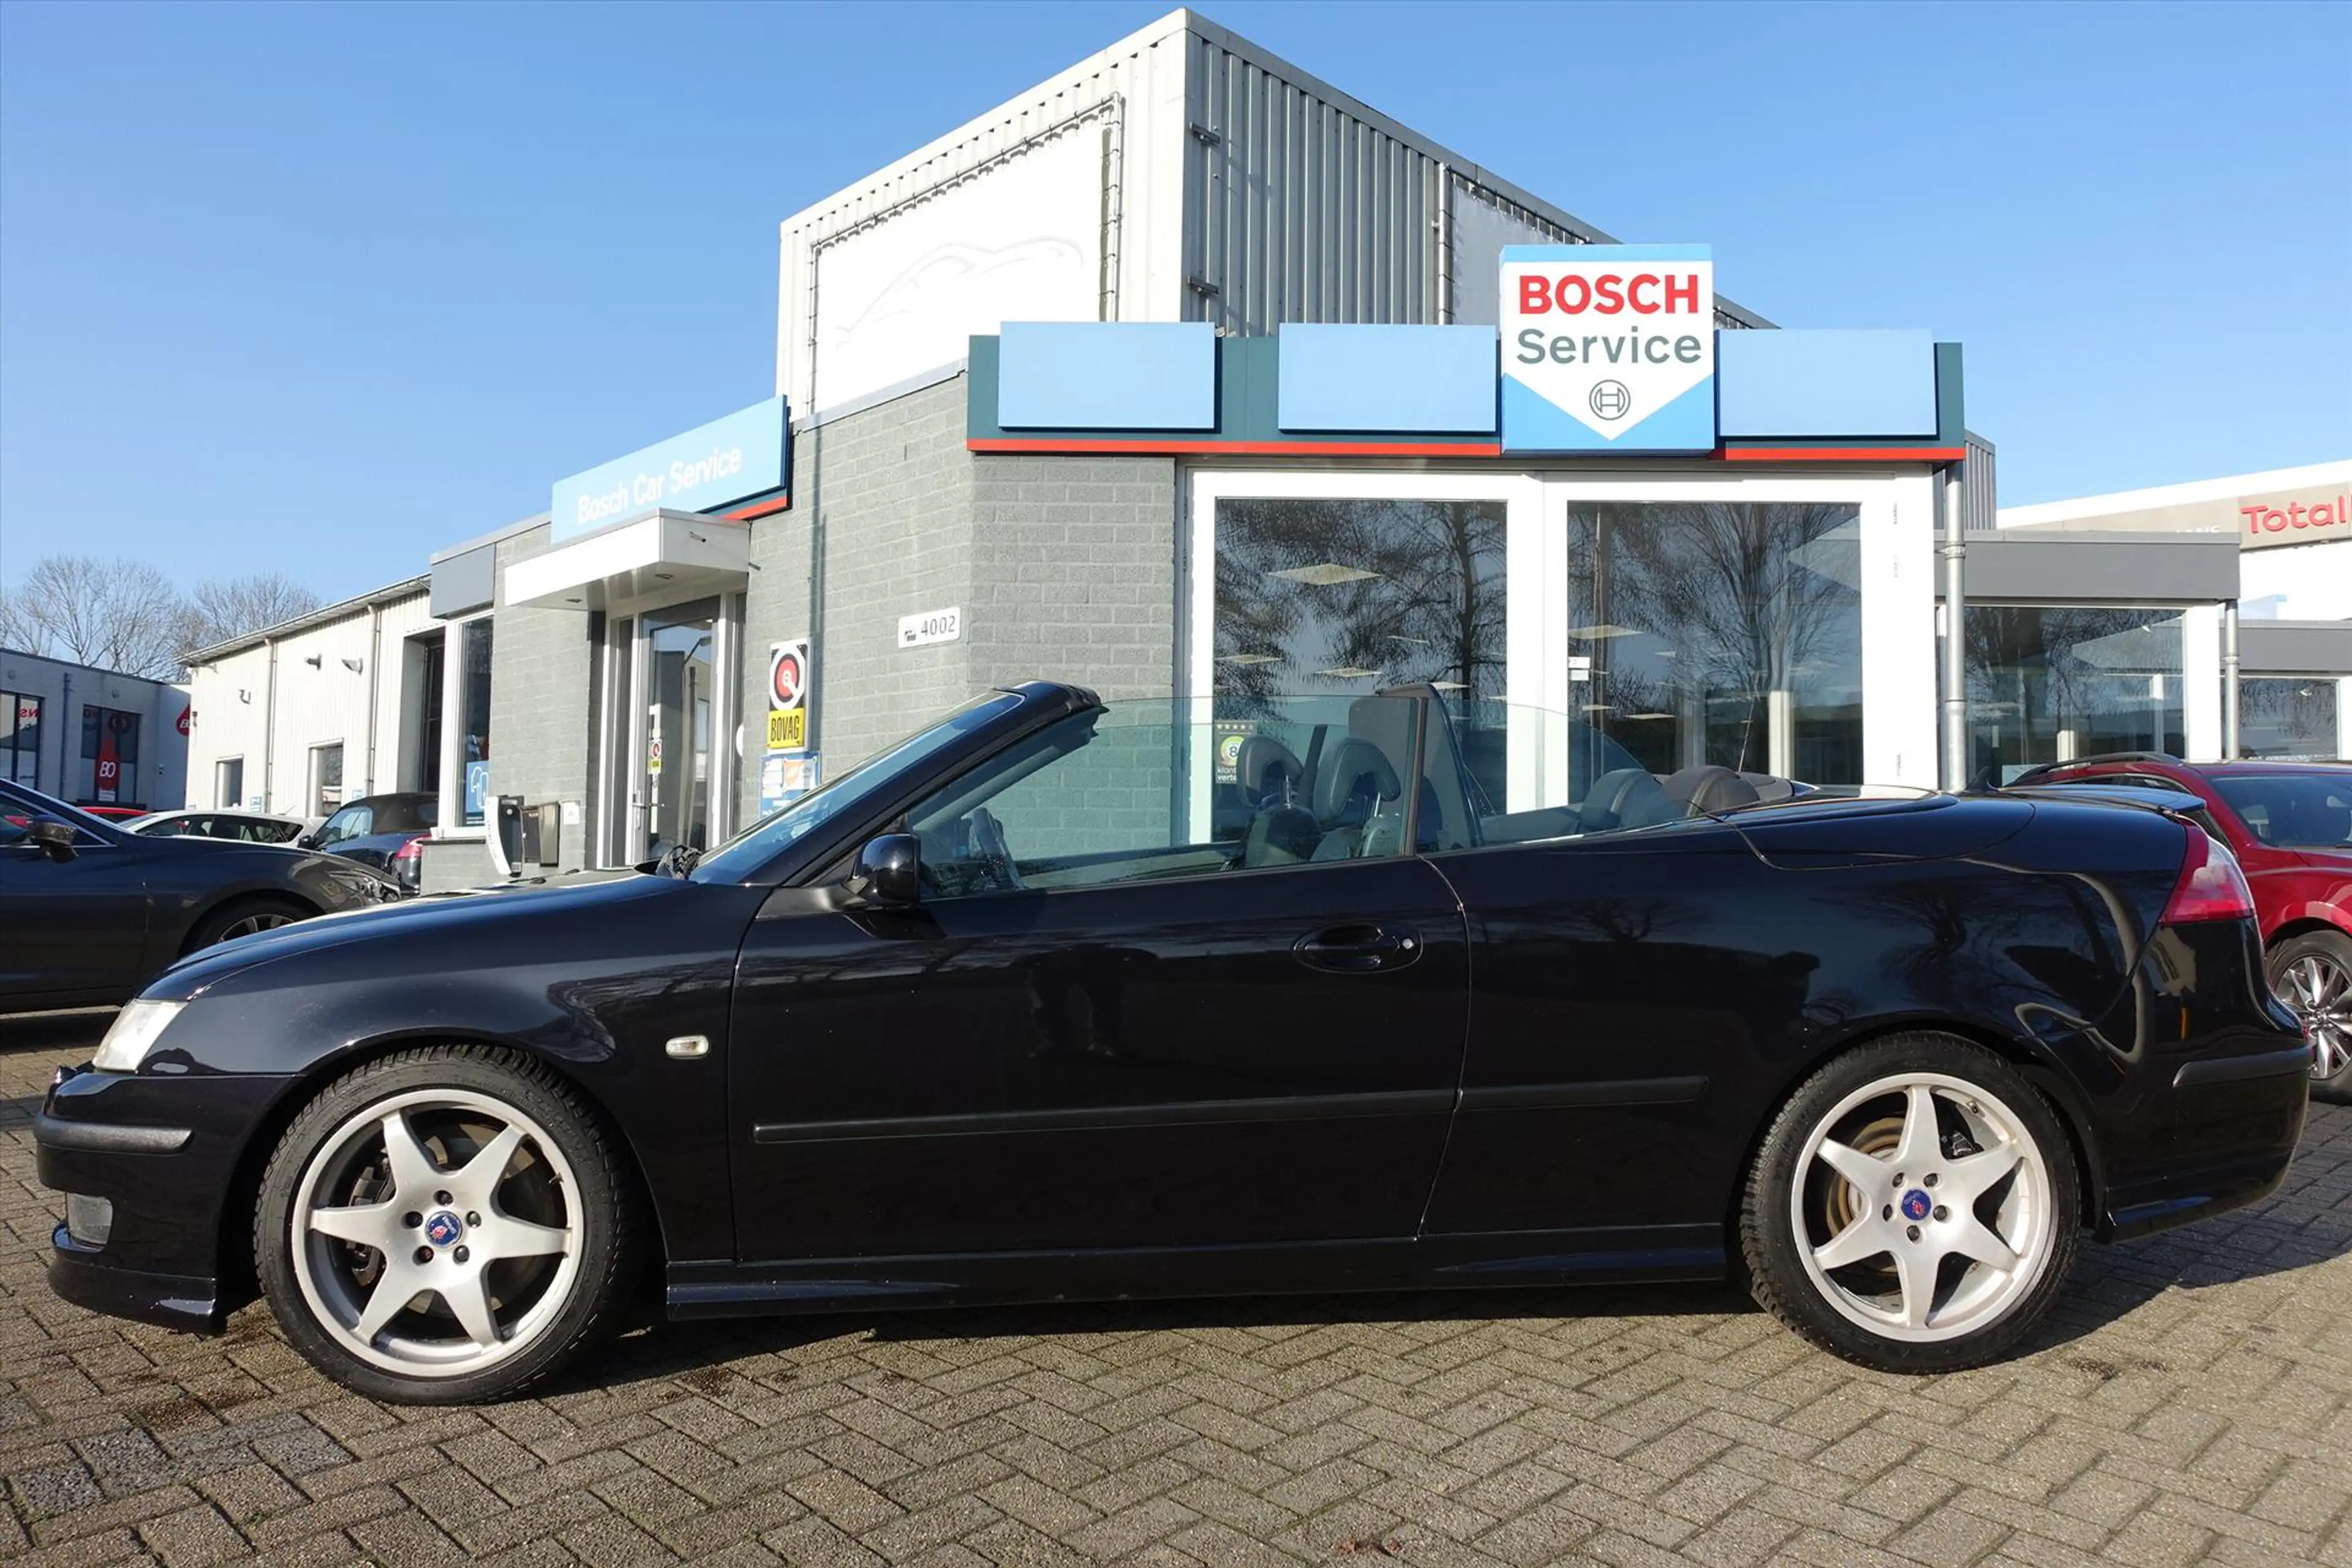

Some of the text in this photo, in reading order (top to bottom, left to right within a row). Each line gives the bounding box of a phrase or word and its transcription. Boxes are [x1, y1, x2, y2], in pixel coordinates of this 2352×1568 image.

[1519, 274, 1698, 314] BOSCH
[1517, 326, 1702, 364] Service
[578, 447, 742, 524] Bosch Car Service
[2240, 496, 2346, 534] Total
[921, 616, 956, 636] 4002
[770, 715, 800, 742] BOVAG
[99, 761, 116, 778] BO
